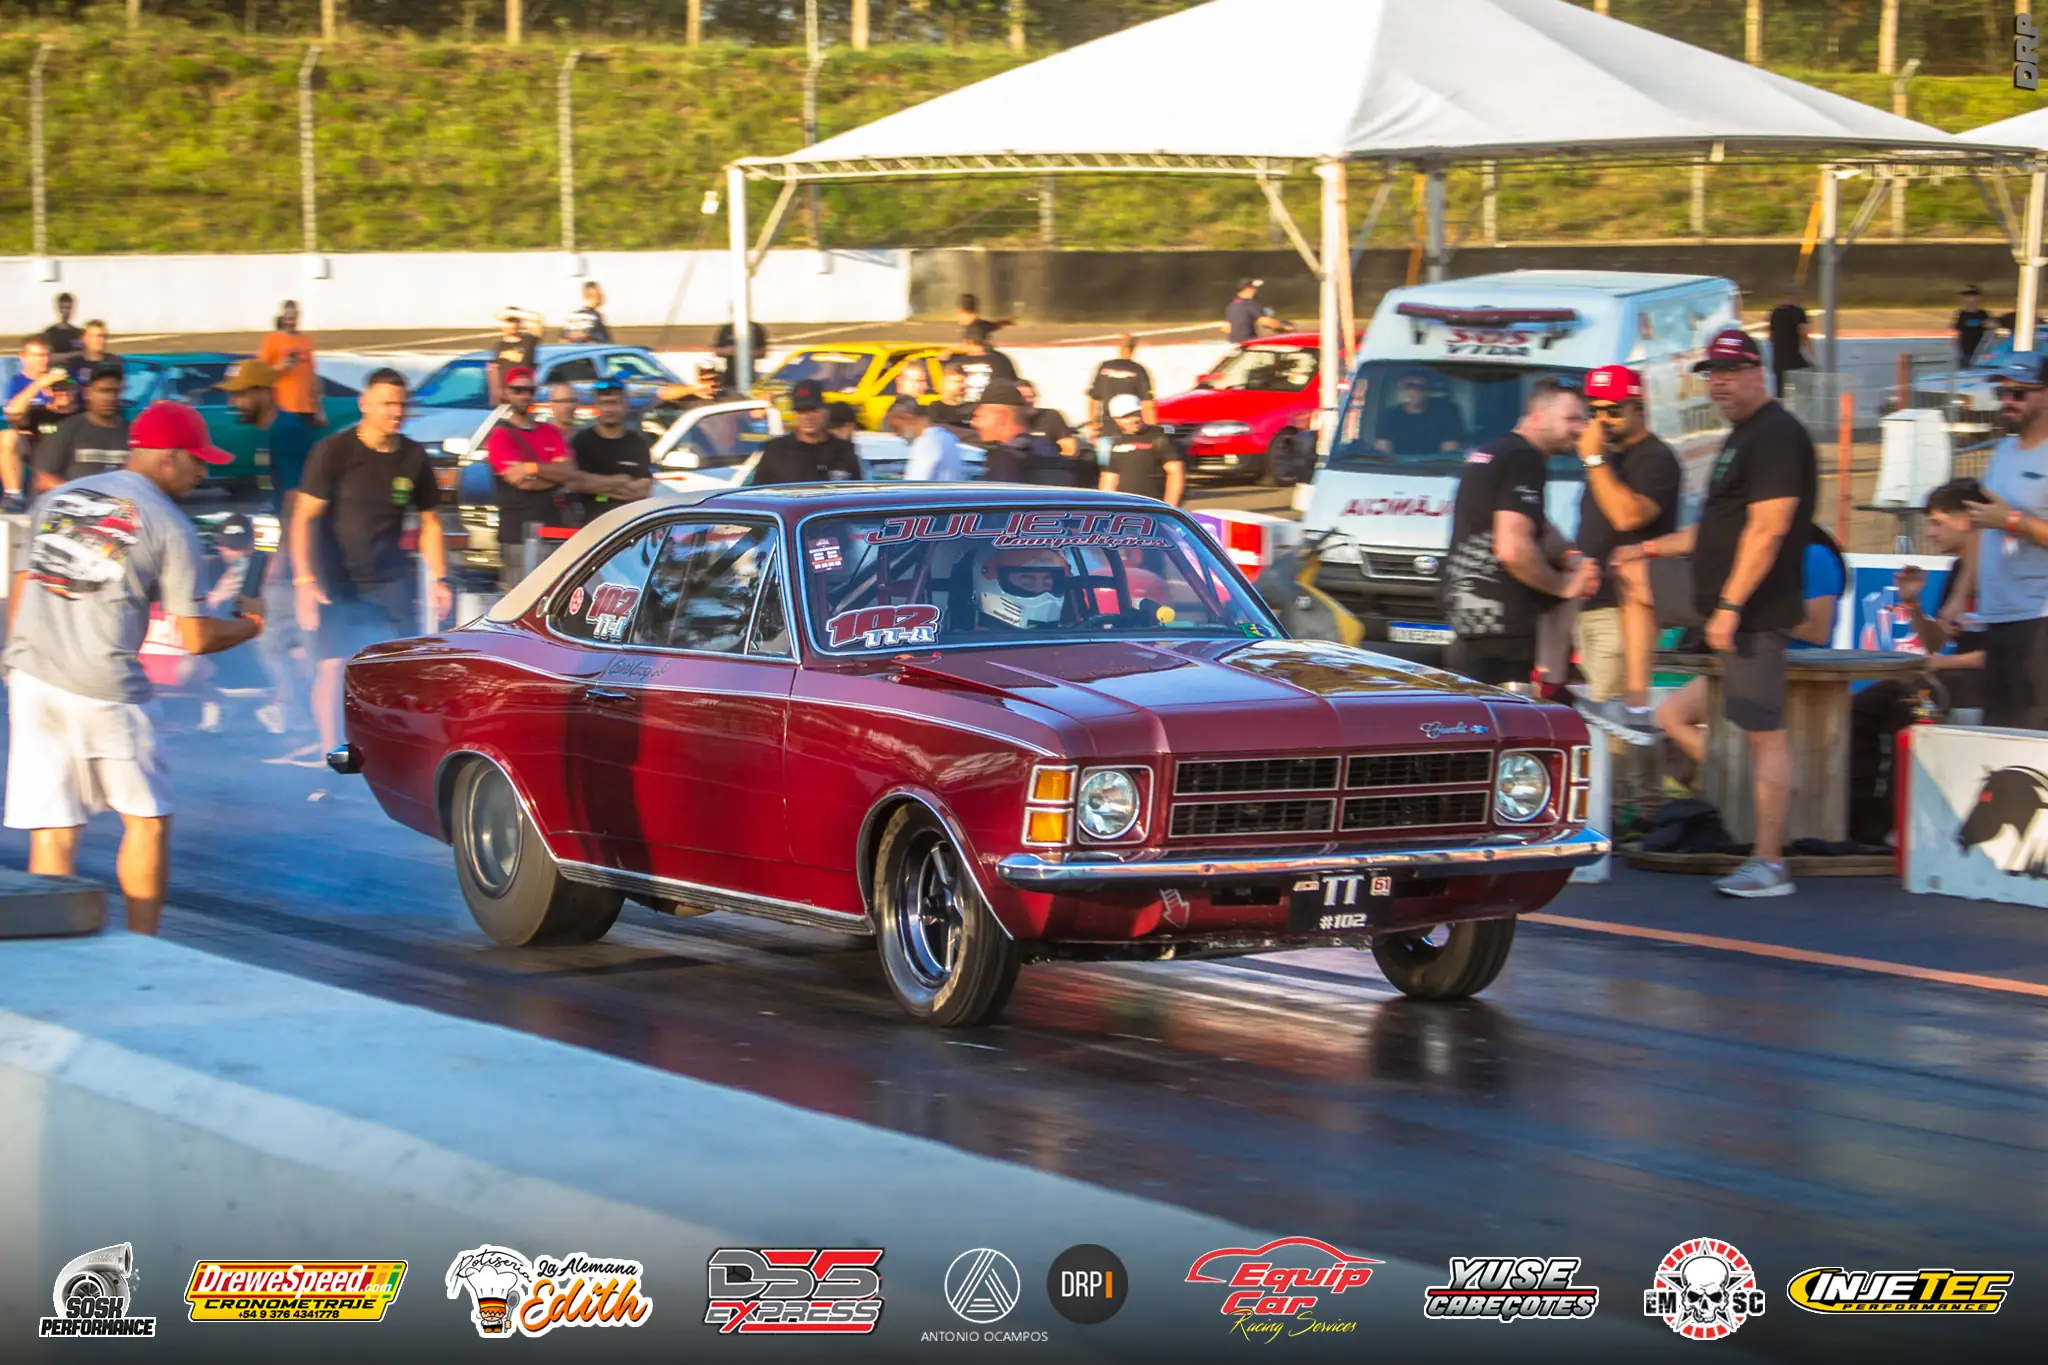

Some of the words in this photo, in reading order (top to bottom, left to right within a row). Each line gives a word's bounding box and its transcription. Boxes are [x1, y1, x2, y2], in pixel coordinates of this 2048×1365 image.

[865, 511, 1157, 545] JULIETA
[586, 582, 642, 624] 102
[826, 604, 942, 647] 102
[1321, 874, 1365, 906] TT
[1319, 912, 1368, 930] #102
